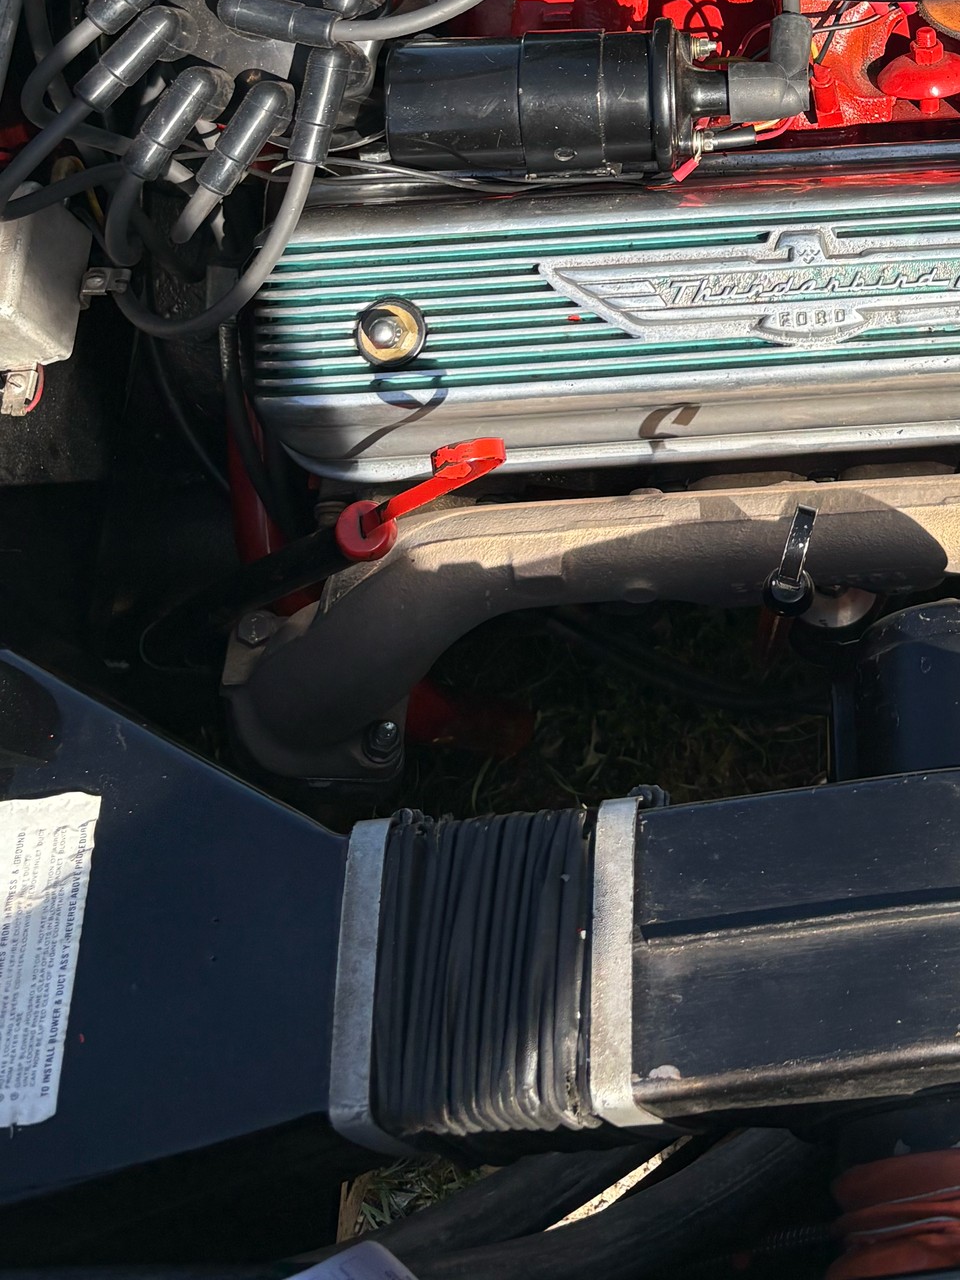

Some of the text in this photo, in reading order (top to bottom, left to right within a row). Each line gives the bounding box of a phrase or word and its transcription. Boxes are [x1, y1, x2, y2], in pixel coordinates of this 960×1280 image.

[667, 268, 950, 305] Thunderbird
[777, 308, 847, 328] FORD
[0, 921, 11, 946] FROM
[13, 831, 25, 864] GROUND
[70, 870, 82, 898] ABOVE
[54, 973, 66, 996] DUCT
[47, 1006, 62, 1044] BLOWER
[41, 1045, 55, 1083] INSTALL
